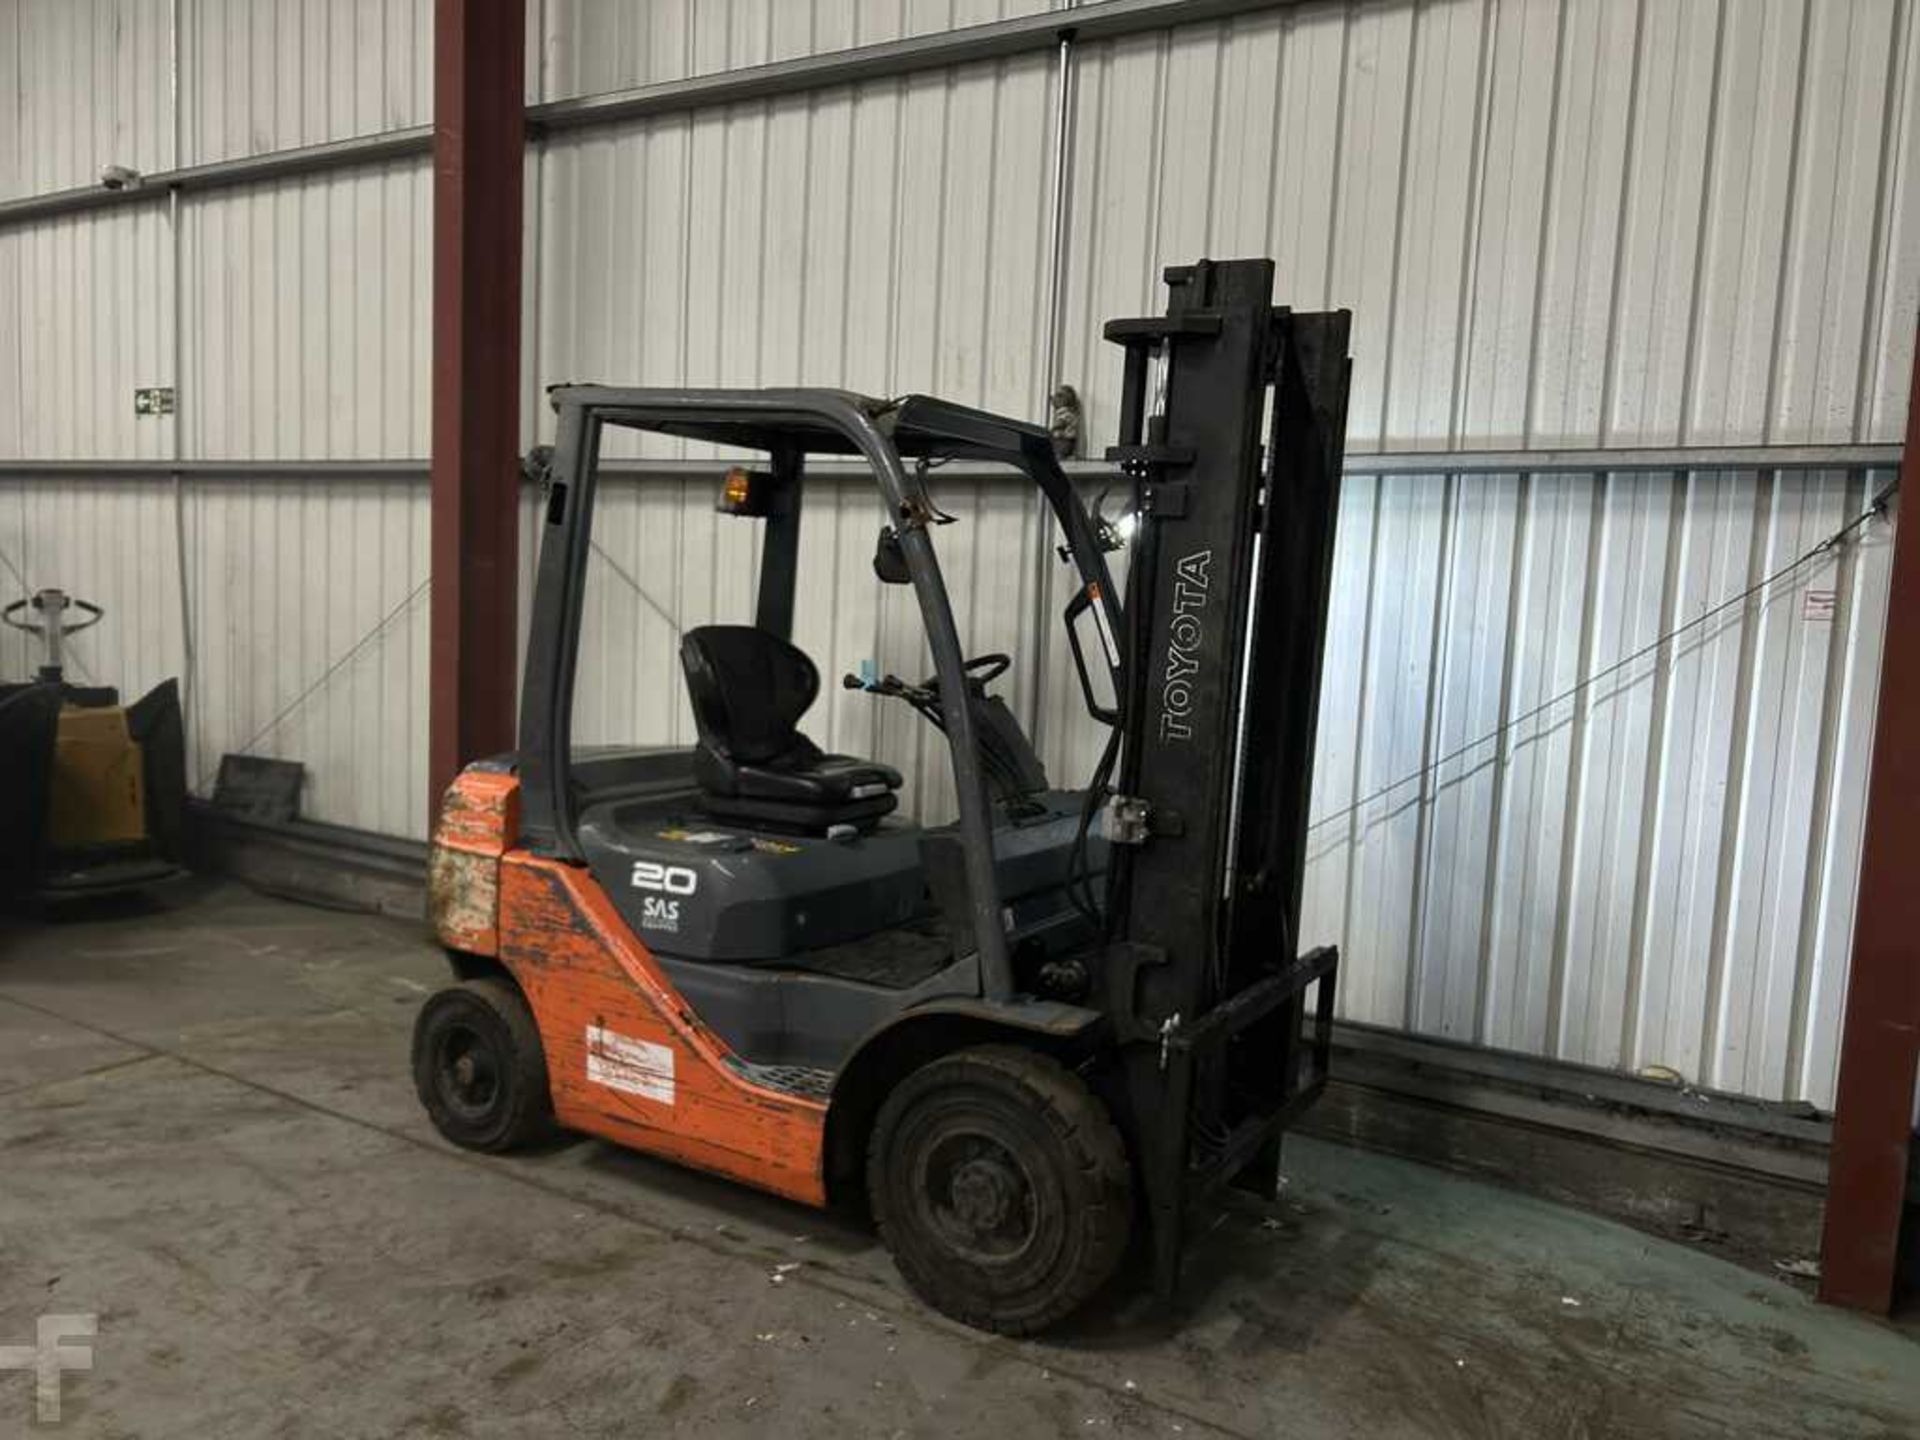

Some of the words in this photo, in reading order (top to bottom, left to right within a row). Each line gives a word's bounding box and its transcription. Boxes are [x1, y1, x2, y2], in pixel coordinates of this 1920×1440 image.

[1160, 550, 1211, 743] TOYOTA
[631, 861, 697, 895] 20
[643, 897, 679, 920] SAS
